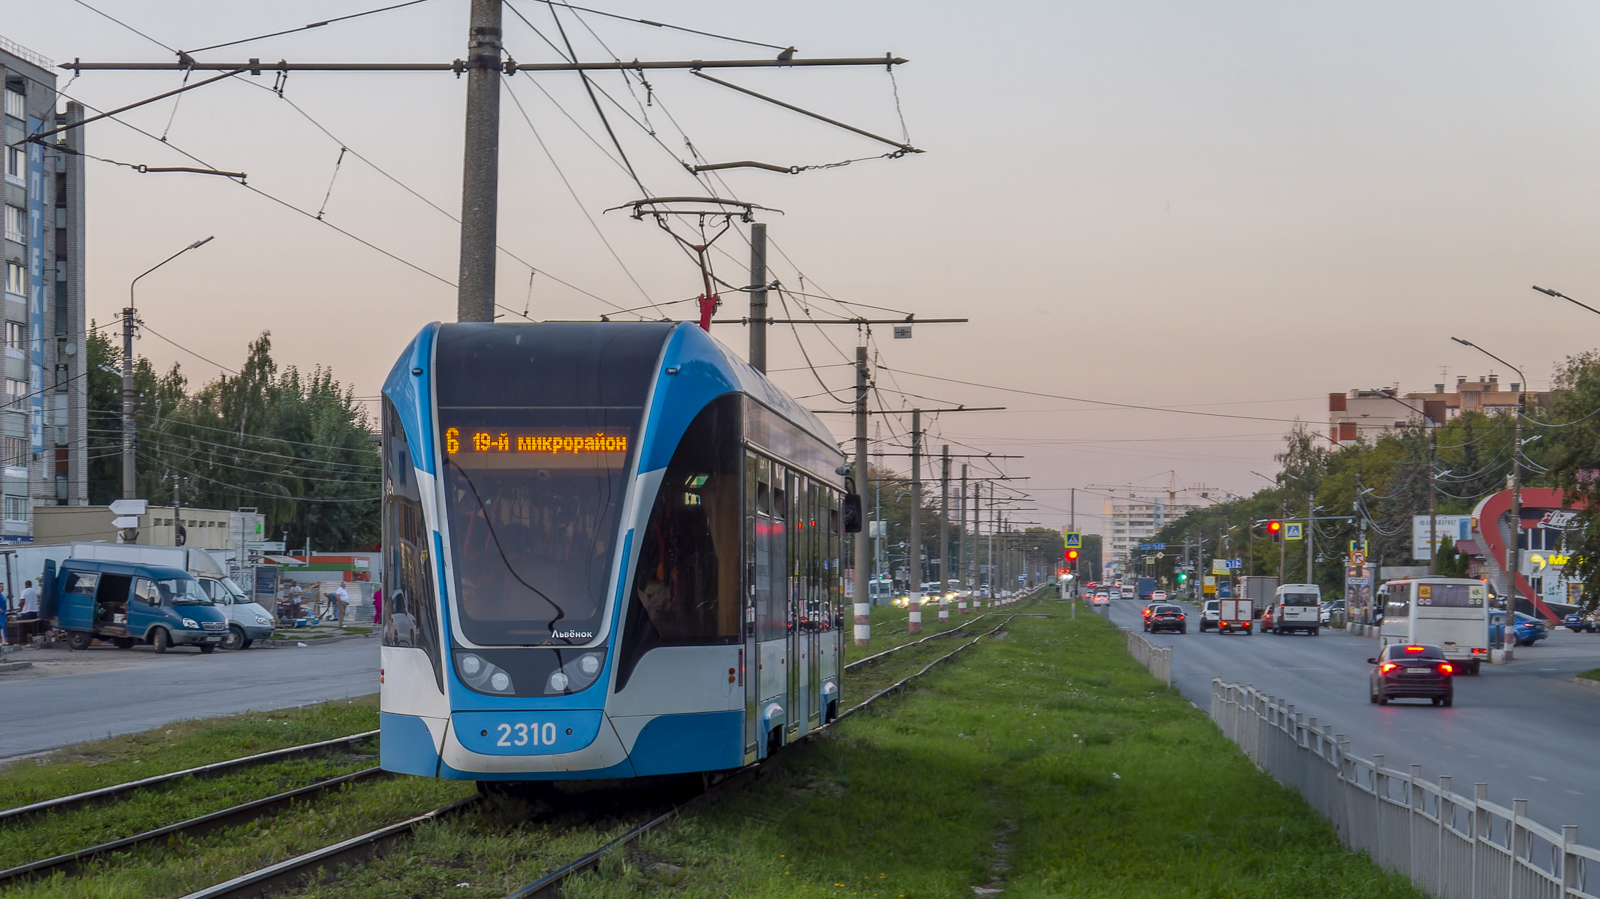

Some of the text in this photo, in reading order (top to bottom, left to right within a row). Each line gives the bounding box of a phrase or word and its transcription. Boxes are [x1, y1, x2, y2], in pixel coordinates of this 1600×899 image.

[31, 144, 41, 352] АПТЕКА
[446, 427, 627, 454] 6 19-й микрорайон
[551, 629, 593, 638] Львёнок
[496, 722, 557, 747] 2310
